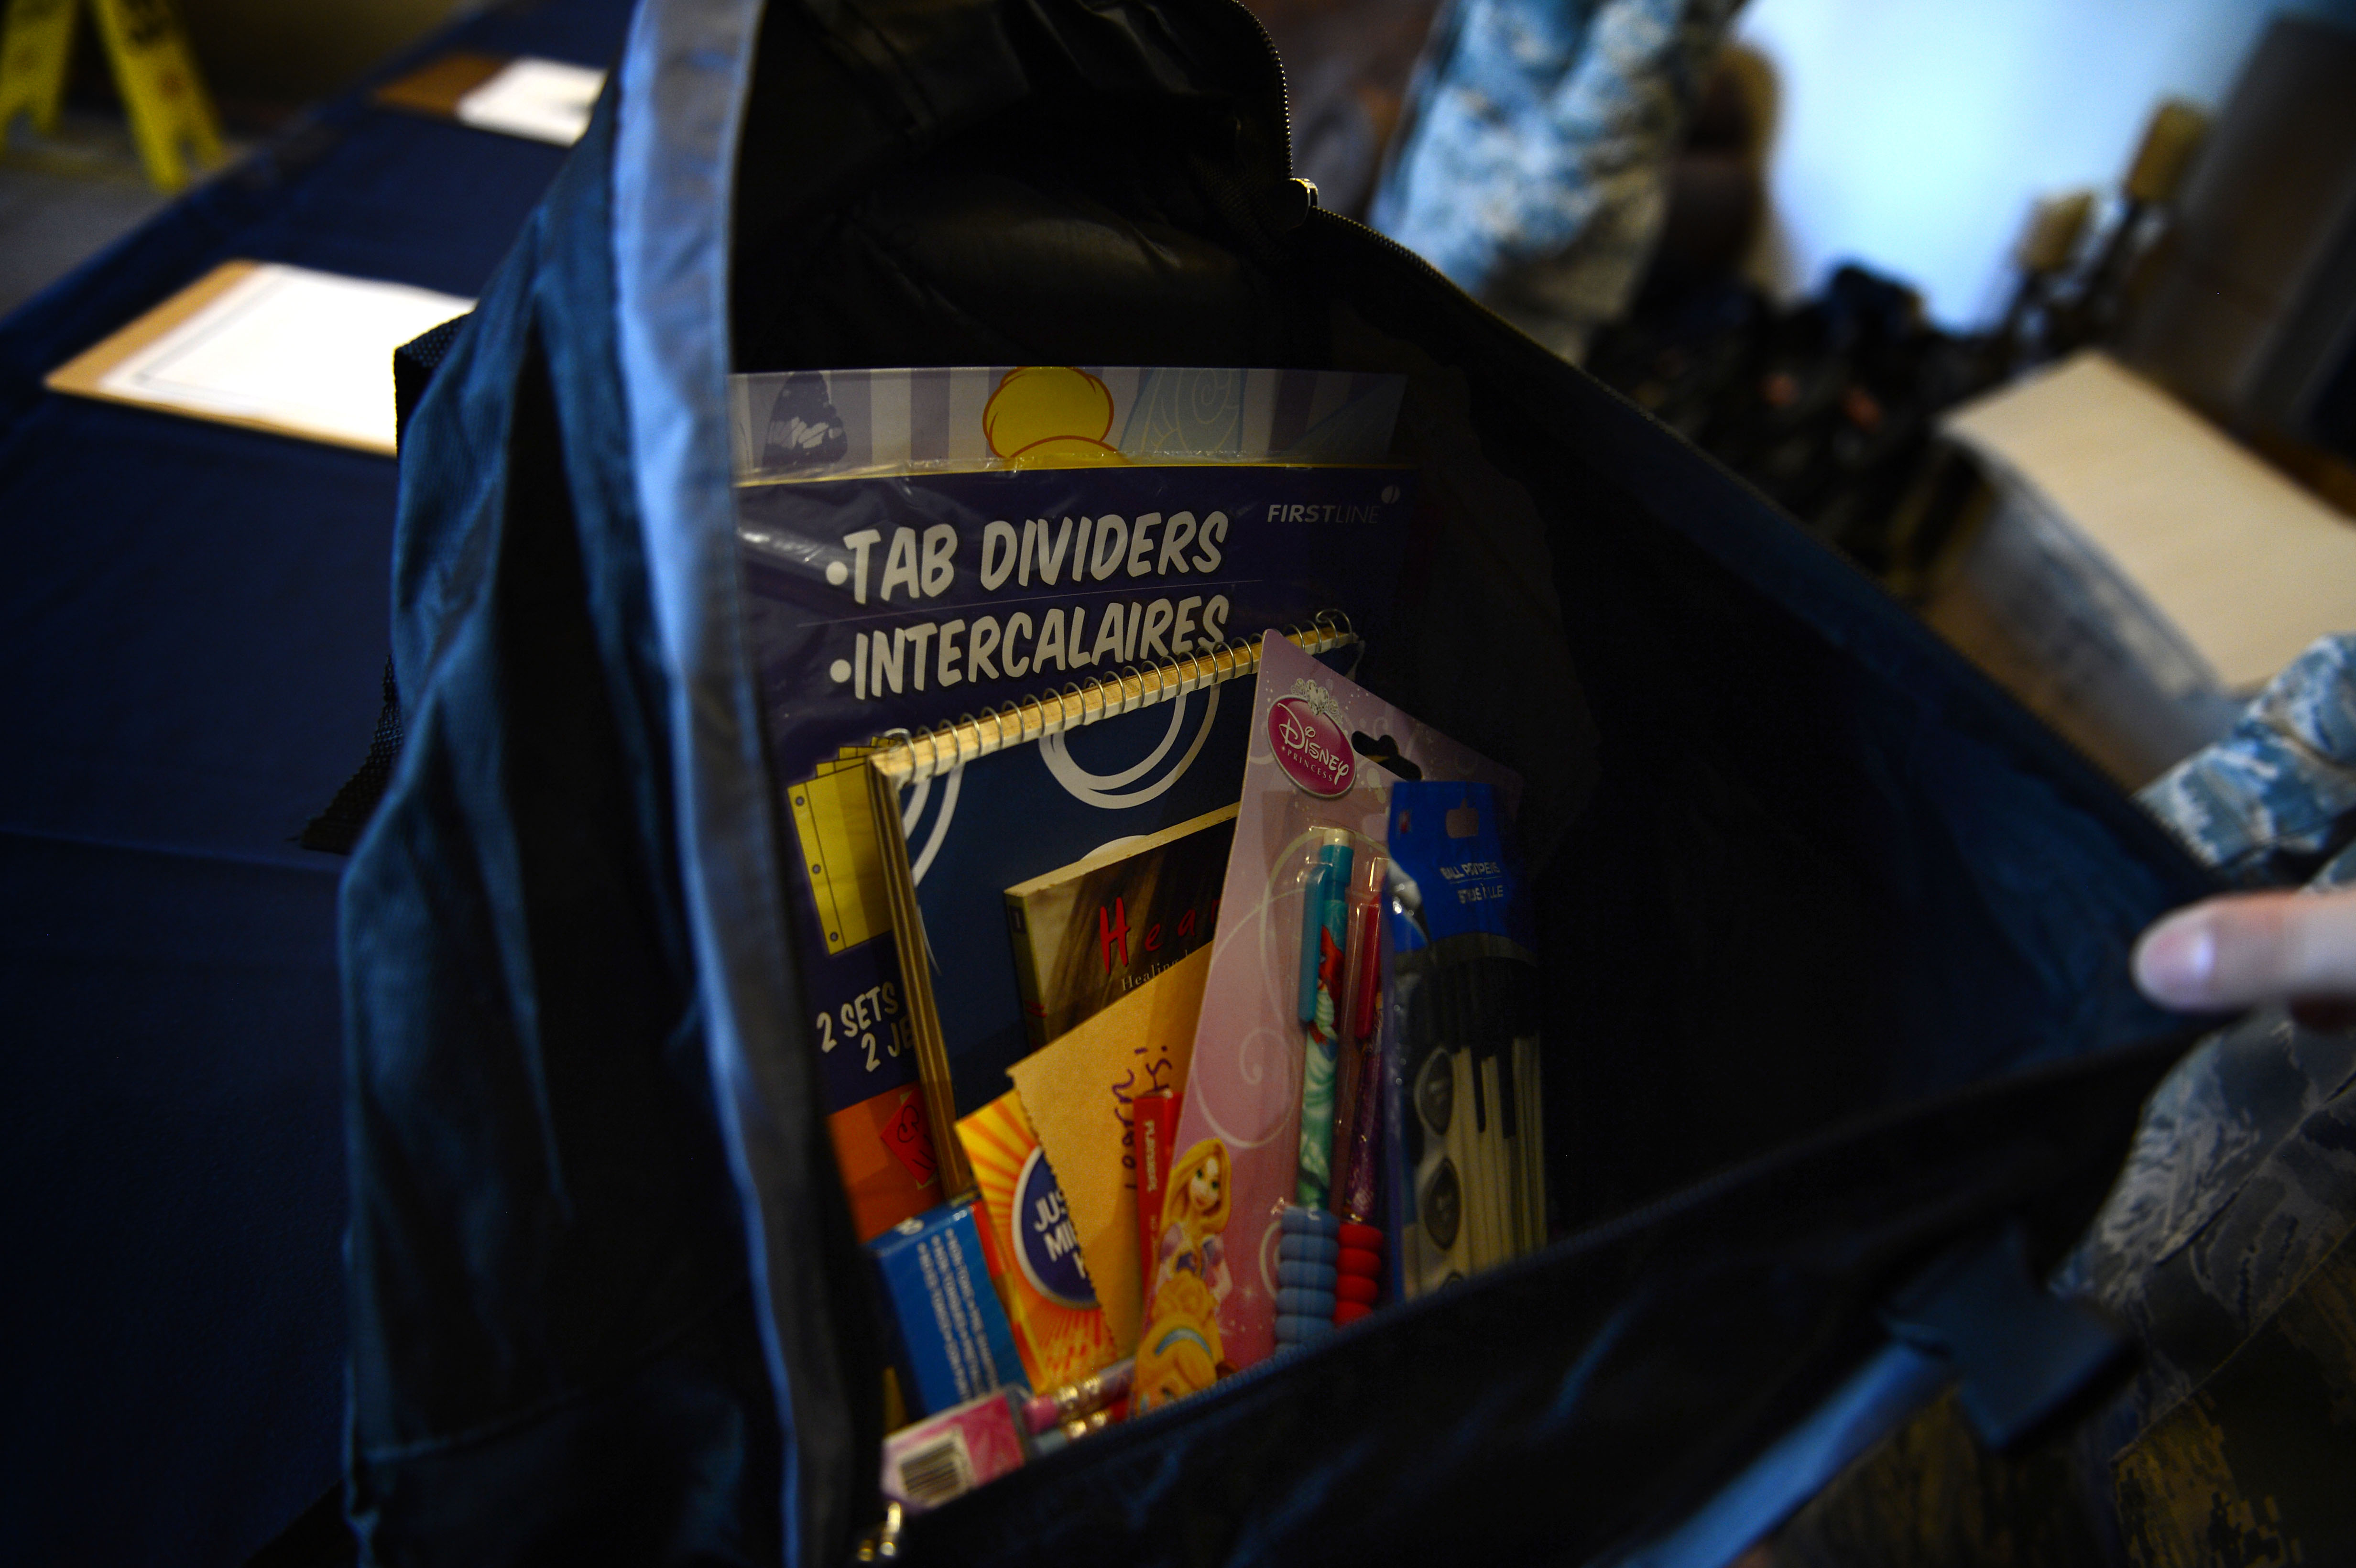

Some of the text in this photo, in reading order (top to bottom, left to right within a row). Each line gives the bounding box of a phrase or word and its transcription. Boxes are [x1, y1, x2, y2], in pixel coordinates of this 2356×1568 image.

[1267, 504, 1381, 524] FIRSTLINE
[844, 511, 1229, 604] TAB DIVIDERS
[854, 594, 1230, 699] INTERCALAIRES
[1287, 749, 1332, 782] PRINCESS
[816, 981, 899, 1053] 2 SETS
[861, 1032, 881, 1072] 2
